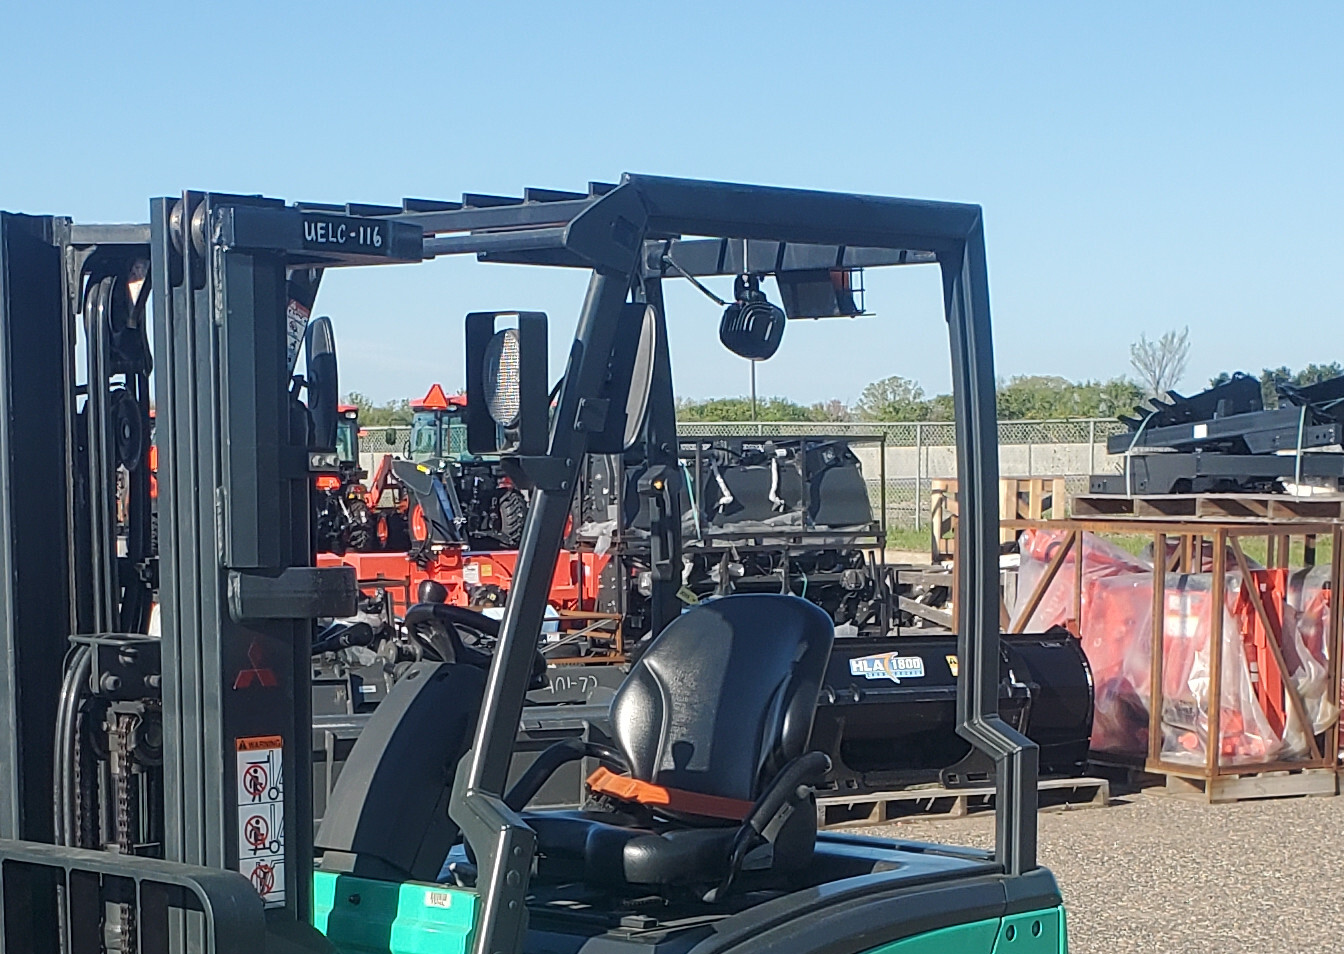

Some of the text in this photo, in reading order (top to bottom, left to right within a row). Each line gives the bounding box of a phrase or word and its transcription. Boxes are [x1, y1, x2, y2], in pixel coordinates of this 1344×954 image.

[304, 221, 383, 248] UELC-116
[851, 658, 922, 672] HLA 1800
